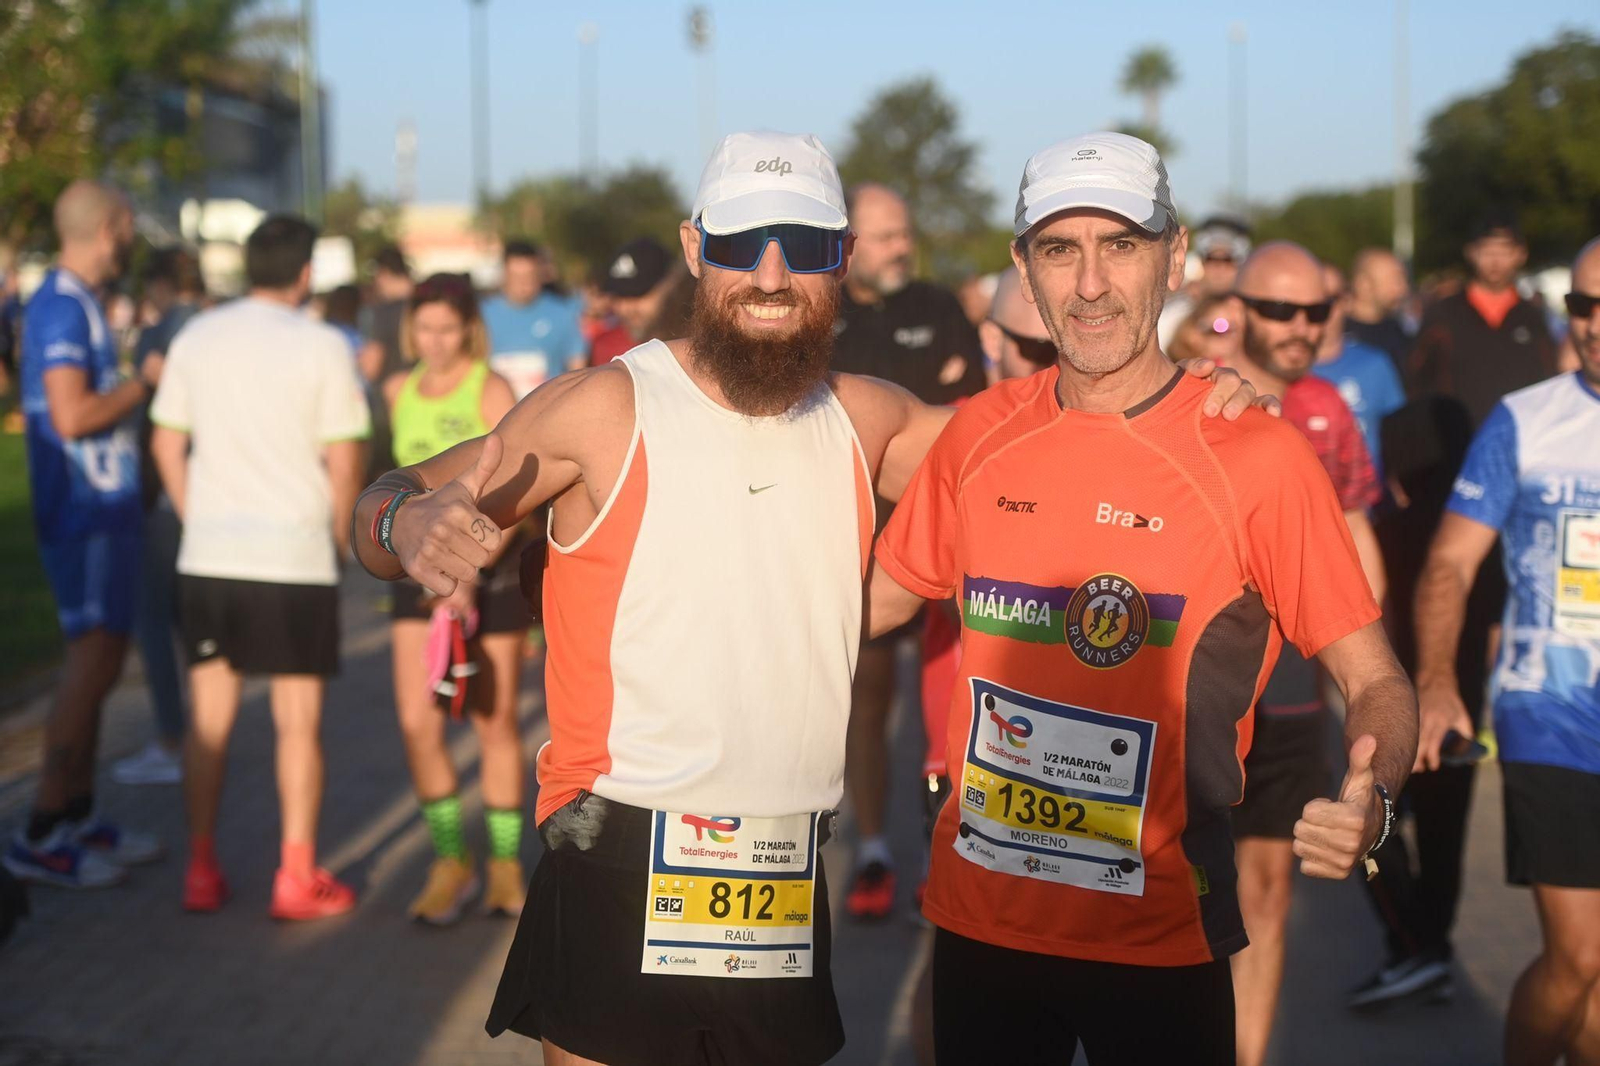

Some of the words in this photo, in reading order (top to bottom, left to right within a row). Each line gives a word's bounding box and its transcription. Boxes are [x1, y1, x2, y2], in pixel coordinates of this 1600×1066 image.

[754, 156, 792, 177] edp
[1005, 501, 1037, 513] TACTIC
[1087, 578, 1133, 600] BEER
[969, 587, 1051, 627] MÁLAGA
[1069, 625, 1140, 663] RUNNERS
[985, 742, 1031, 766] TotalEnergies
[1044, 752, 1059, 763] 1/2
[1060, 756, 1111, 773] MARATÓN
[1043, 765, 1054, 775] DE
[1056, 767, 1101, 785] MÁLAGA
[1104, 776, 1129, 790] 2022
[998, 783, 1088, 834] 1392
[753, 841, 766, 851] 1/2
[767, 840, 796, 851] MARATÓN
[1010, 830, 1068, 849] MORENO
[679, 847, 738, 860] TotalEnergies
[752, 854, 762, 864] DE
[764, 853, 791, 864] MÁLAGA
[792, 854, 805, 864] 2022
[709, 882, 775, 920] 812
[725, 929, 756, 942] RAÚL
[670, 956, 697, 965] CaixaBank
